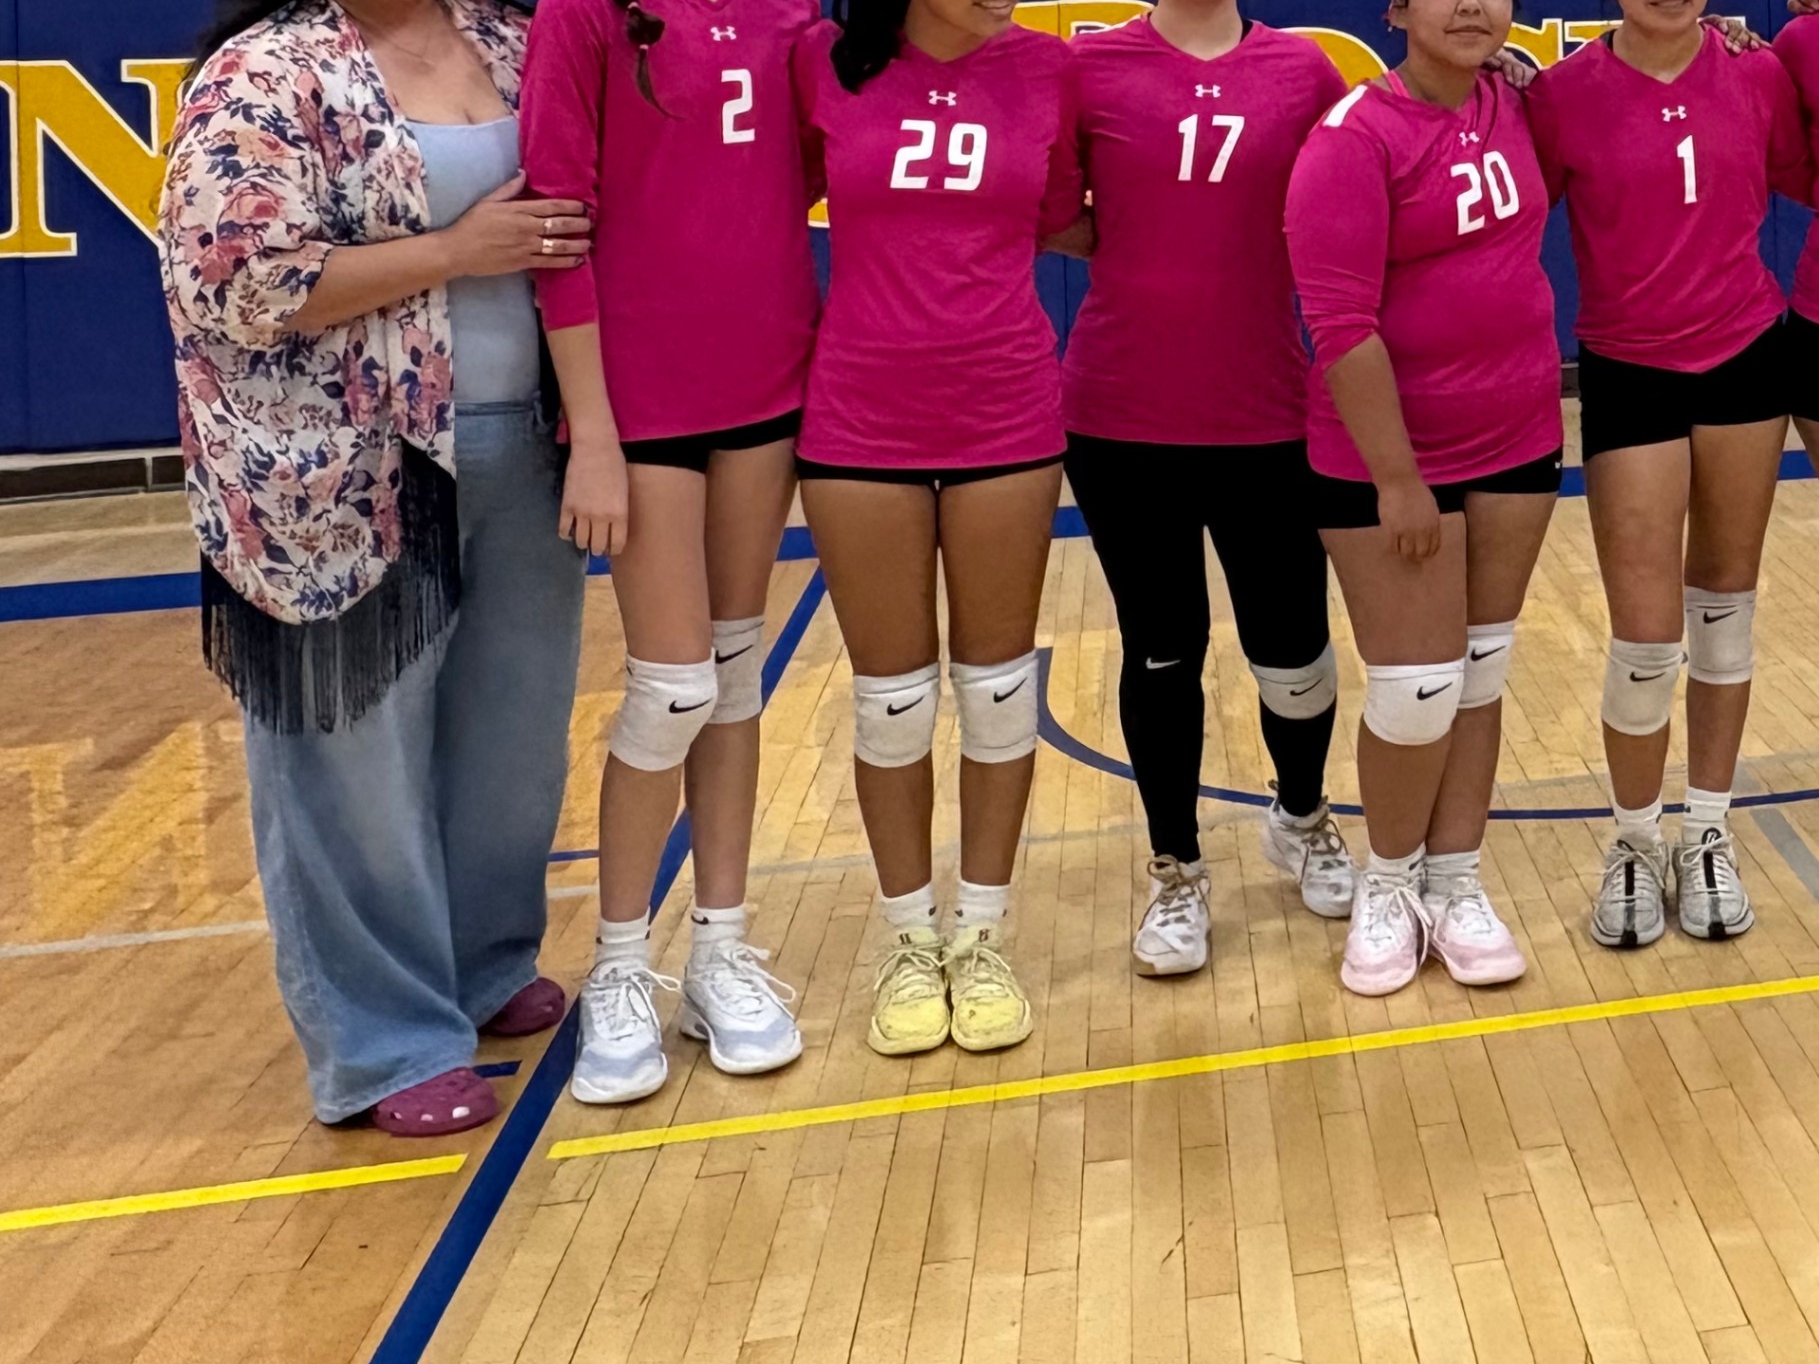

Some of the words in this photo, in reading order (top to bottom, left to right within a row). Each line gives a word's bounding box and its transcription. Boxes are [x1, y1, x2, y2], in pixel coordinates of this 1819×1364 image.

[721, 68, 756, 145] 2
[889, 118, 989, 192] 29
[1177, 113, 1246, 183] 17
[1676, 135, 1697, 206] 1
[1449, 149, 1521, 236] 20
